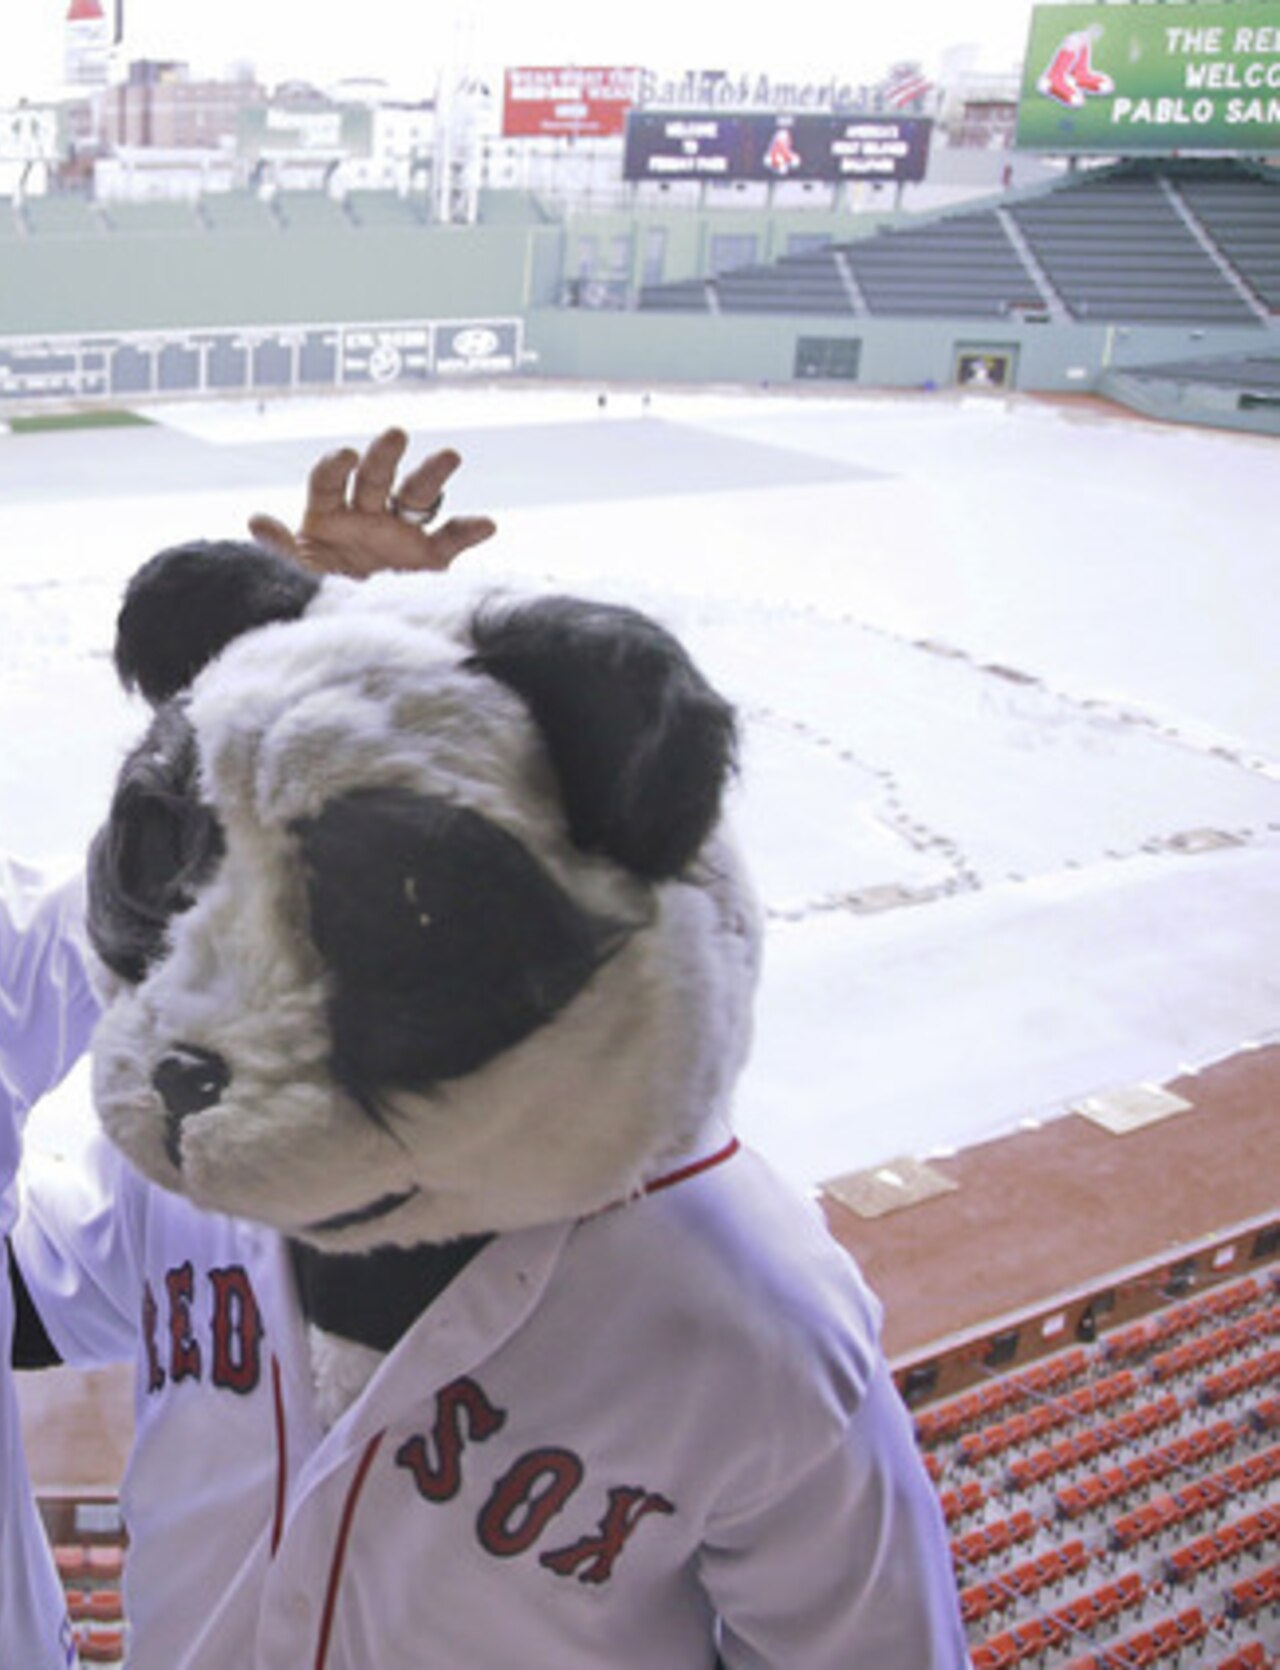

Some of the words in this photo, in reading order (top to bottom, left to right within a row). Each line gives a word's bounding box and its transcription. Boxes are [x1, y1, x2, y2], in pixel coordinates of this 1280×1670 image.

[1166, 27, 1223, 54] THE
[1112, 98, 1214, 123] PABLO
[395, 1376, 676, 1585] SOX
